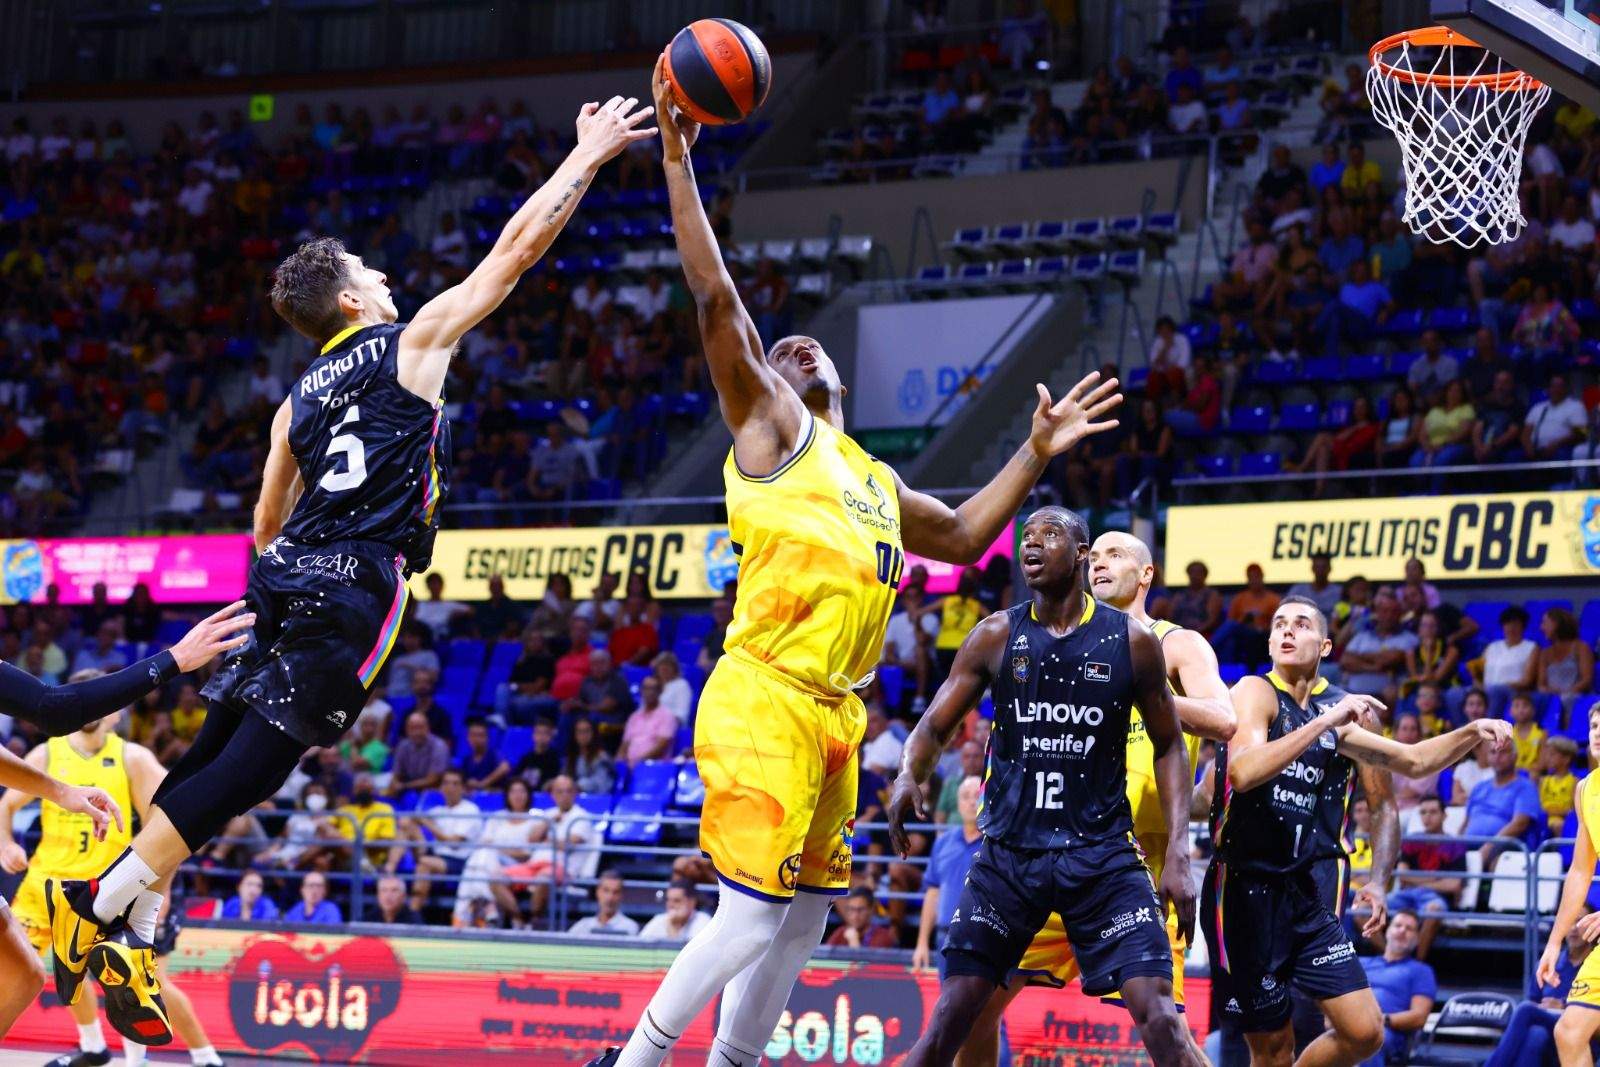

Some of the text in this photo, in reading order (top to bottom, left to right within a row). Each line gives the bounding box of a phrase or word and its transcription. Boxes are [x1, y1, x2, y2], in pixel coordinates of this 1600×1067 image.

[301, 337, 387, 398] RICHOTTI
[319, 405, 368, 493] 5
[1271, 500, 1554, 571] ESCUELITAS CBC
[463, 533, 685, 591] ESCUELITAS CBC
[1014, 698, 1104, 727] Lenovo
[1035, 771, 1065, 810] 12
[79, 831, 90, 853] 3
[1293, 824, 1303, 858] 1
[735, 867, 764, 885] SPALDING
[1100, 919, 1136, 939] Canarias
[254, 959, 368, 1031] isola
[763, 993, 884, 1066] sola
